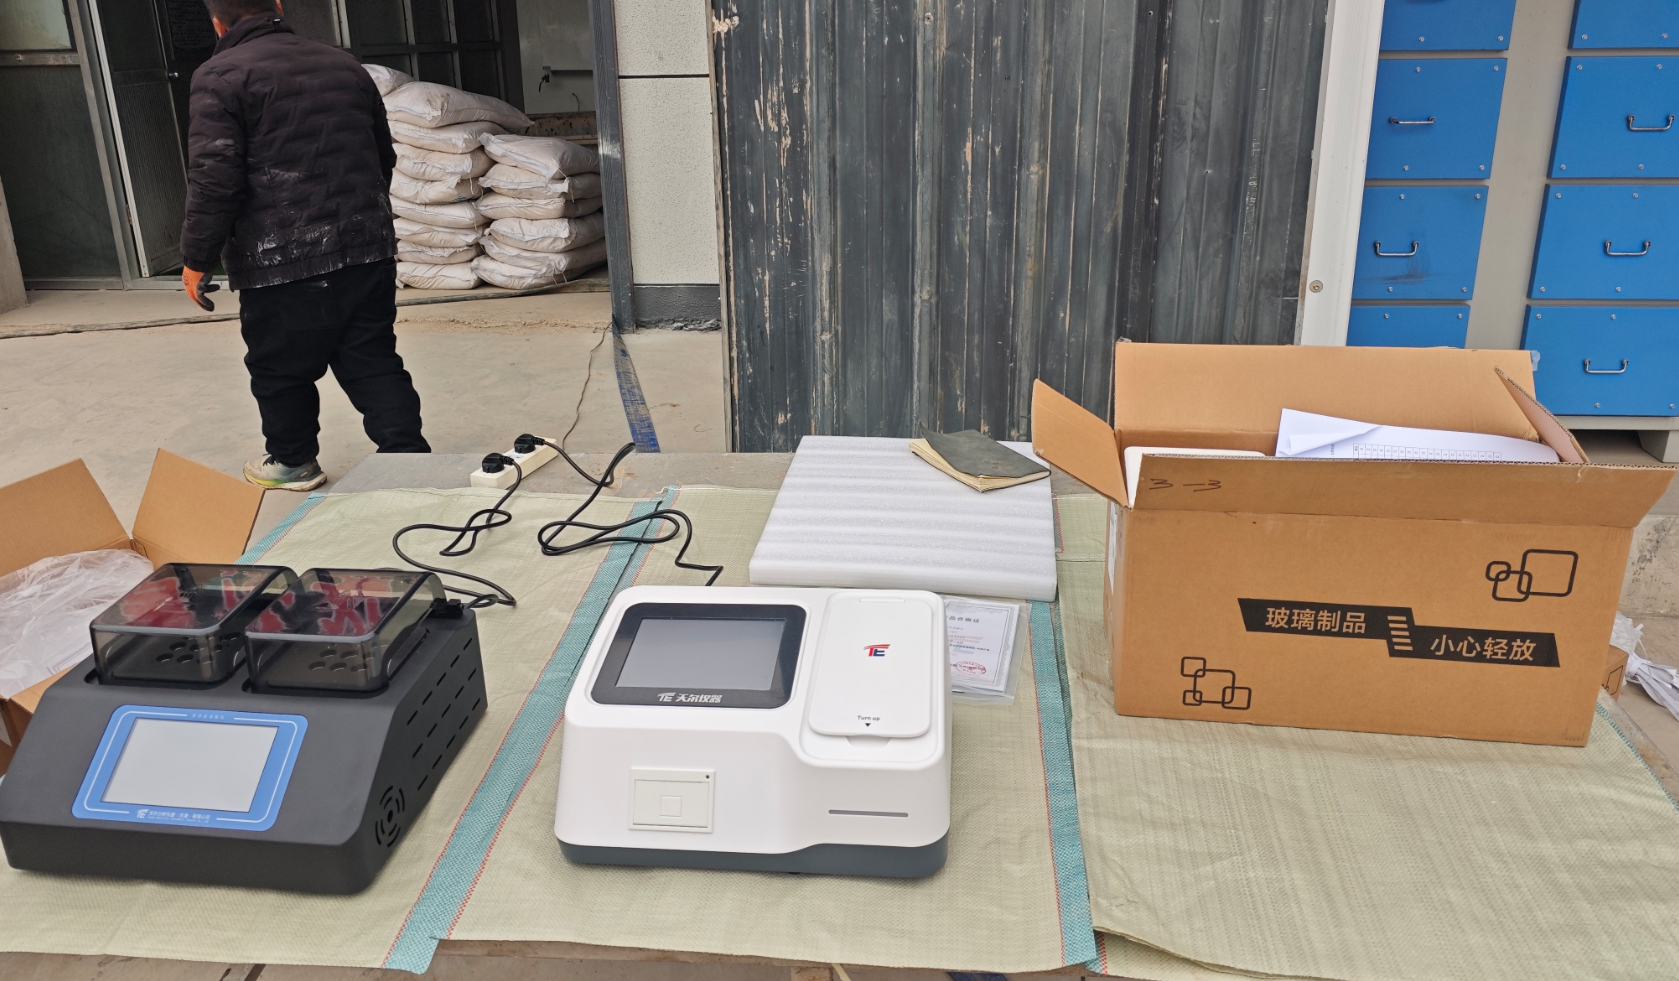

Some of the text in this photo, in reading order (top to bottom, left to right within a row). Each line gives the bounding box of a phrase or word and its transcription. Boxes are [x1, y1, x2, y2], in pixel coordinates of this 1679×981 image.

[1265, 606, 1367, 634] 玻璃制品
[1430, 634, 1537, 662] 小心轻放
[675, 693, 723, 704] 天尔仪器
